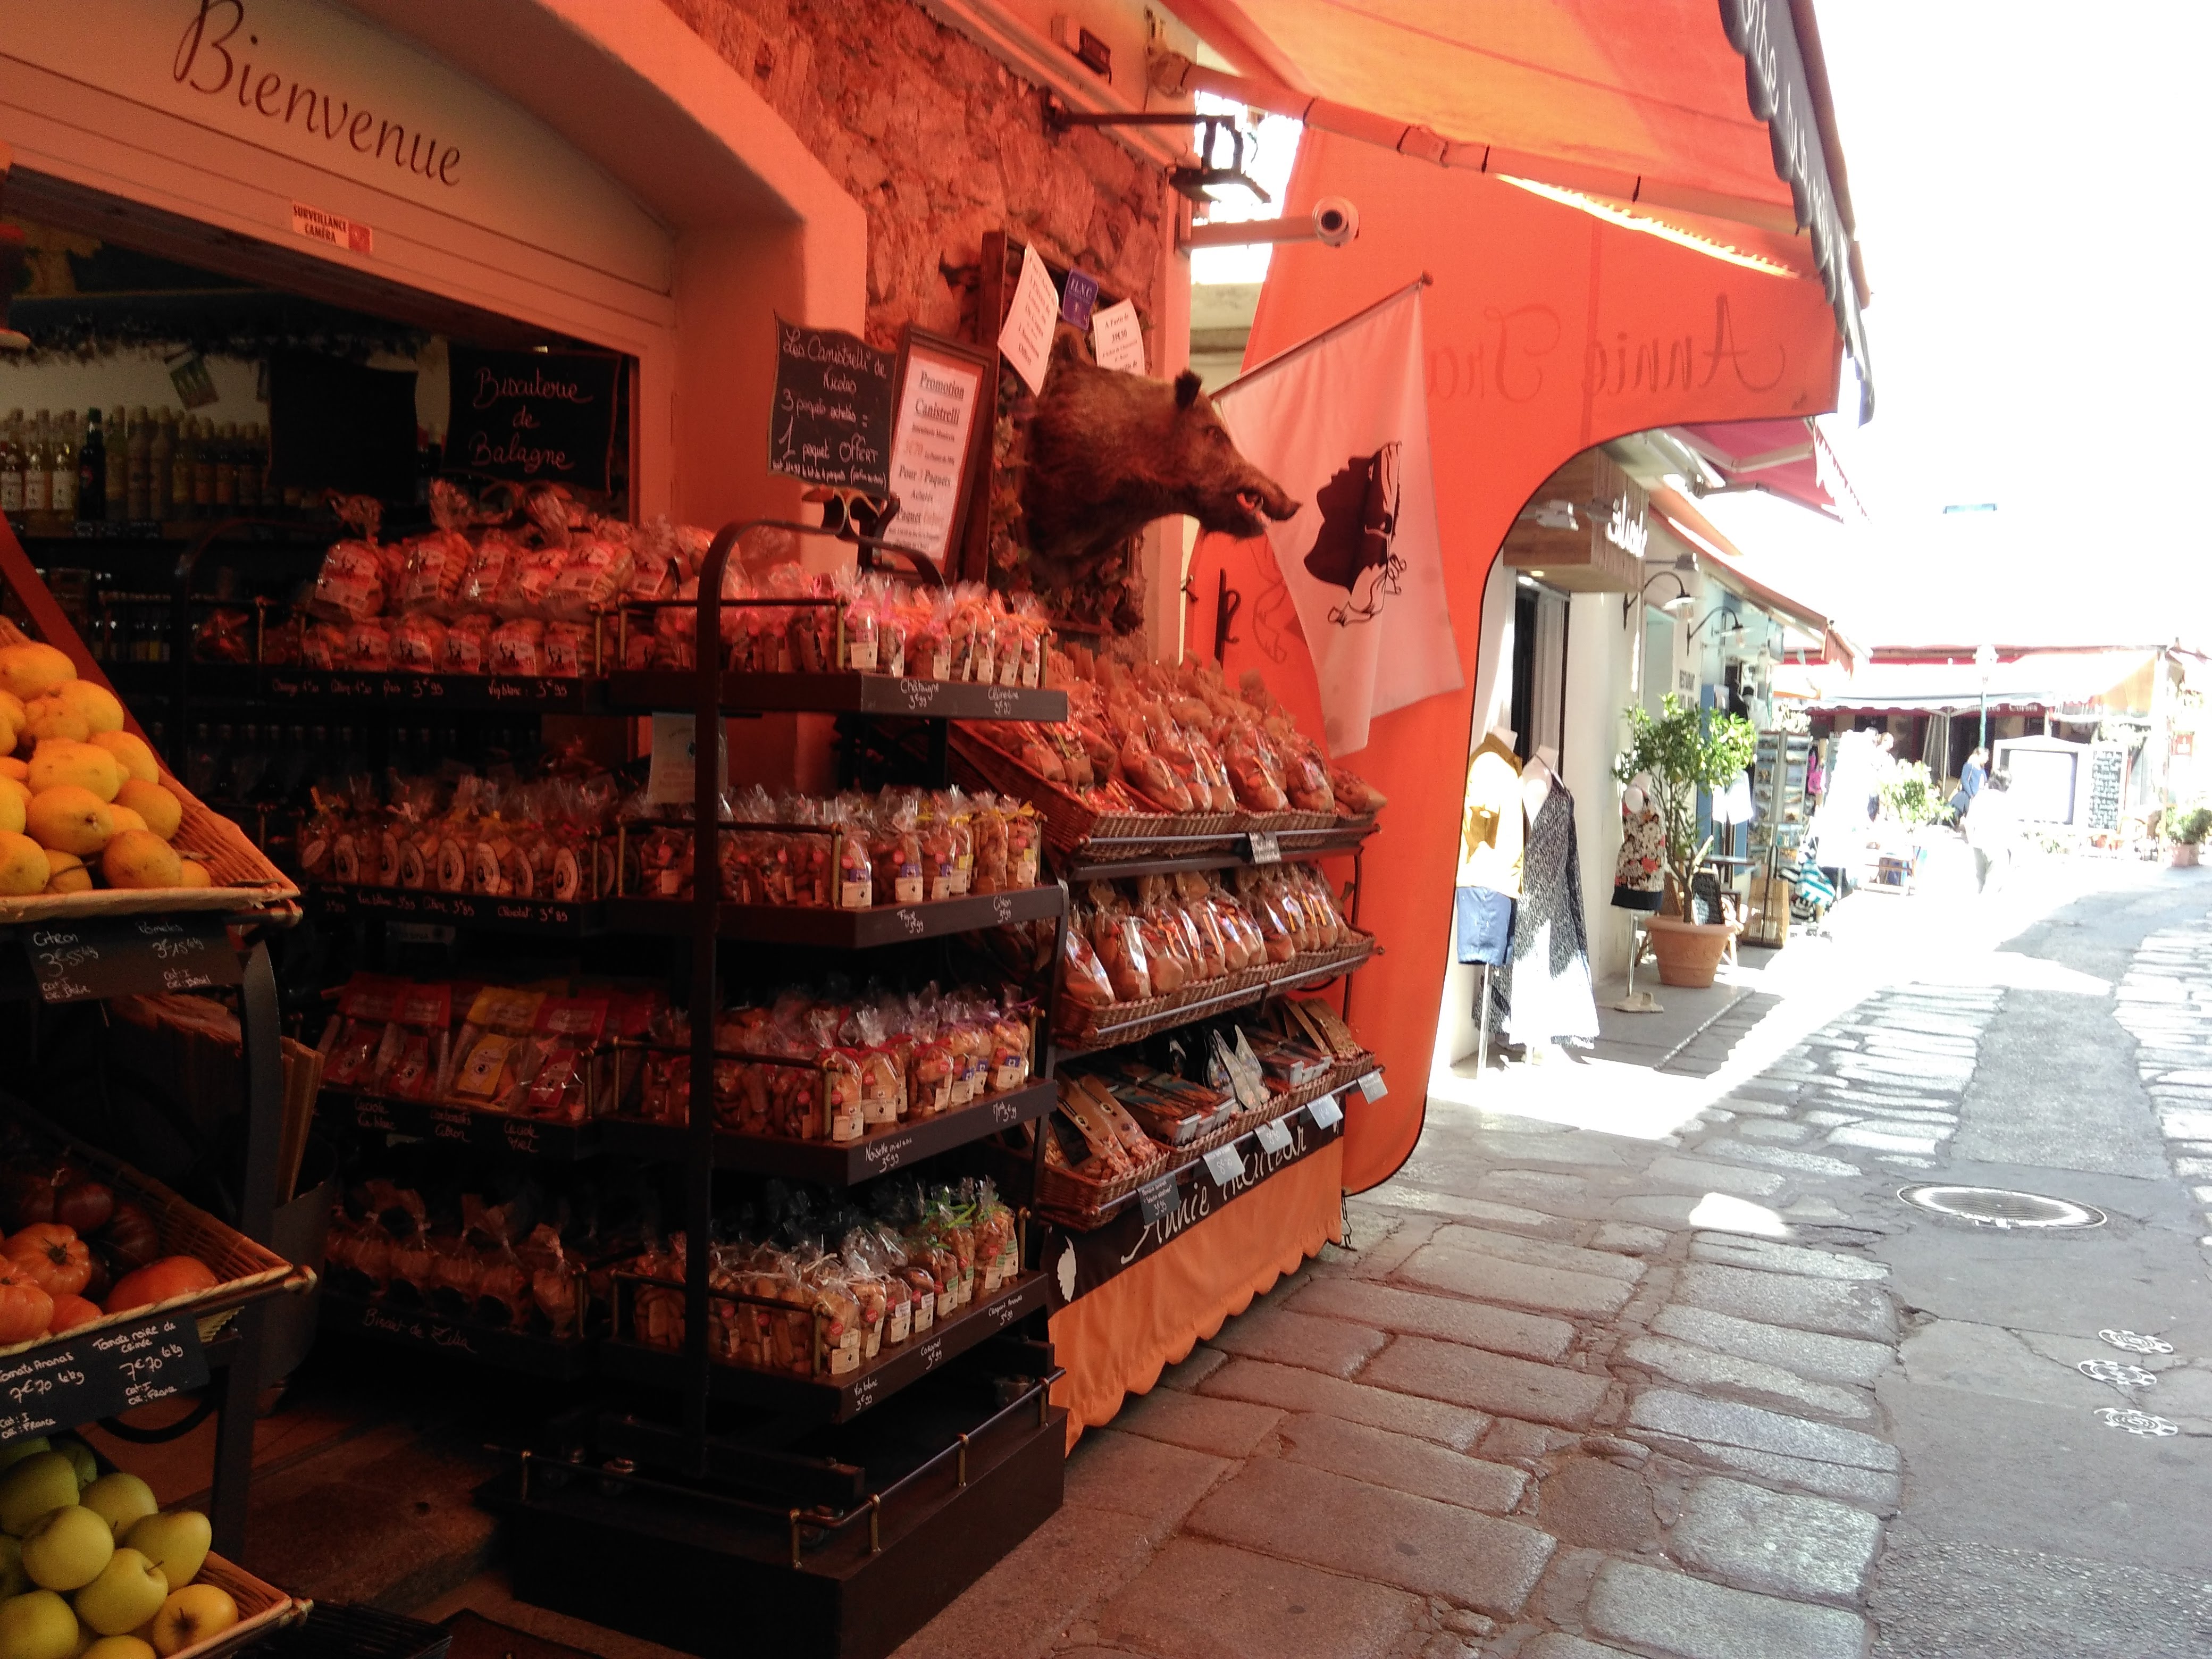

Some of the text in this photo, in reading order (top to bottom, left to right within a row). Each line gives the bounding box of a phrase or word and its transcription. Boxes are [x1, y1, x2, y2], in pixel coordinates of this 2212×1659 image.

[173, 0, 460, 186] Bienvenue
[294, 204, 346, 231] SURVEILLANCE
[783, 328, 805, 357] Les
[919, 371, 965, 400] Promotion
[782, 388, 793, 411] 3
[915, 398, 960, 425] Canistrelli
[512, 404, 541, 430] de
[778, 414, 795, 460] 1
[468, 430, 576, 474] Balagne
[899, 465, 916, 481] Pour
[924, 469, 951, 488] Paquets
[93, 1334, 129, 1351] Tomate
[163, 1321, 177, 1331] de
[119, 1355, 163, 1381] 7€70
[10, 1379, 52, 1404] 7€70
